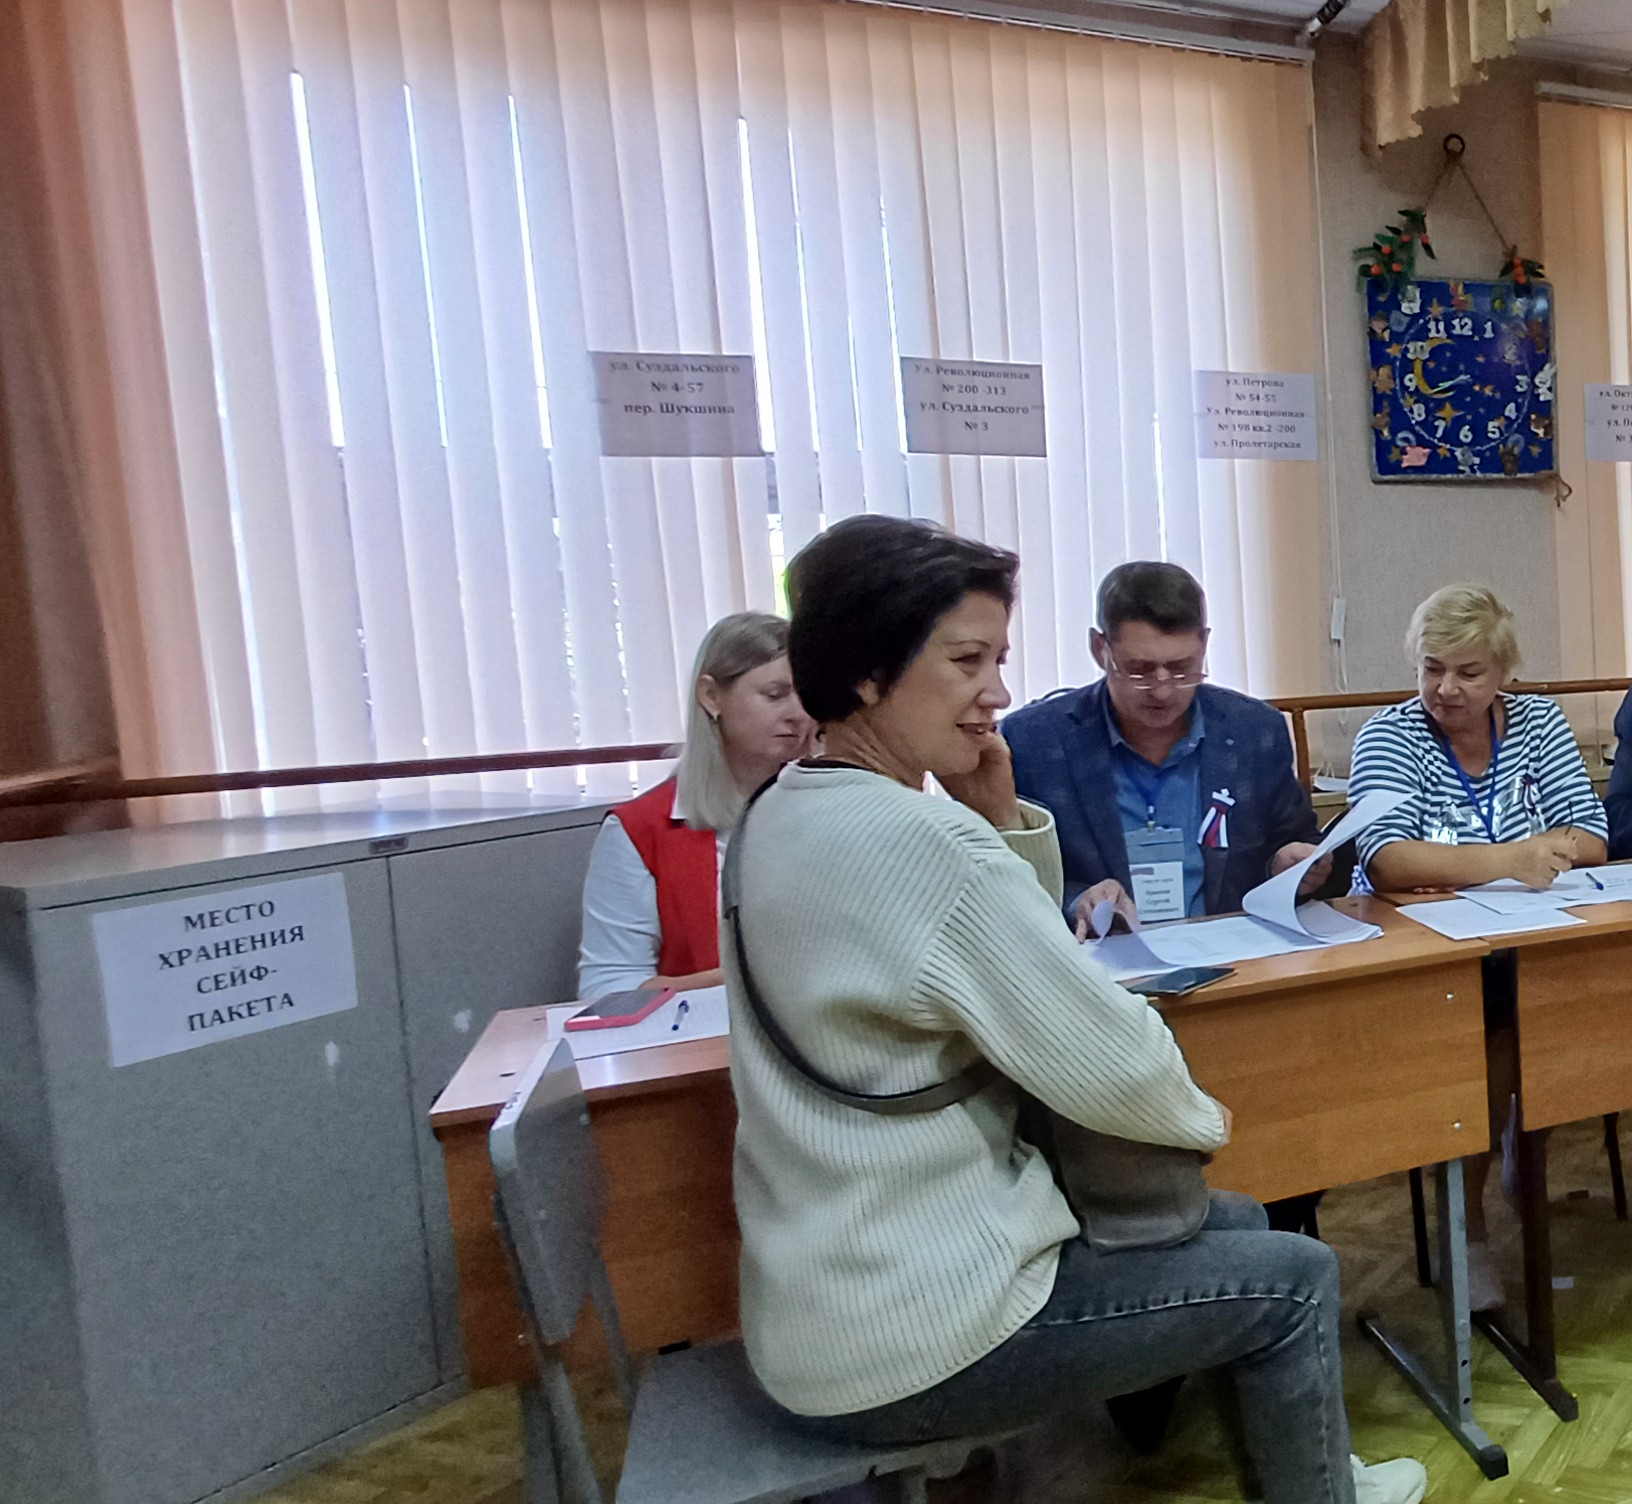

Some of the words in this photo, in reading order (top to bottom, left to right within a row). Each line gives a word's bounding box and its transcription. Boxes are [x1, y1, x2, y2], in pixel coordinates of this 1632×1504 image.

[1427, 318, 1447, 338] 11
[1451, 317, 1473, 335] 12
[1483, 321, 1494, 338] 1
[636, 359, 740, 375] Суздальского
[935, 364, 1030, 380] Революционная
[651, 382, 668, 393] №
[671, 382, 705, 394] 4-57
[942, 383, 955, 394] №
[957, 384, 979, 394] 200
[1226, 378, 1241, 388] ул.
[1243, 377, 1285, 388] Петрова
[1403, 373, 1417, 391] 9
[1515, 375, 1528, 392] 3
[1235, 392, 1247, 402] №
[624, 403, 656, 416] пер.
[659, 402, 736, 416] Шукшина
[920, 401, 939, 412] ул.
[942, 401, 1030, 415] Суздальского
[1224, 407, 1305, 419] Революционная
[1412, 403, 1426, 421] 8
[1504, 402, 1517, 420] 4
[964, 420, 978, 431] №
[981, 421, 989, 431] 3
[1217, 423, 1229, 431] №
[1231, 423, 1251, 432] 198
[1434, 419, 1446, 438] 7
[1487, 421, 1500, 439] 5
[1607, 420, 1621, 429] ул.
[1459, 425, 1473, 443] 6
[1213, 440, 1229, 450] ул.
[1231, 439, 1302, 450] Пролетарская
[183, 900, 275, 932] МЕСТО
[157, 925, 305, 970] ХРАНЕНИЯ
[196, 963, 279, 995] СЕЙФ-
[187, 992, 295, 1032] ПАКЕТА
